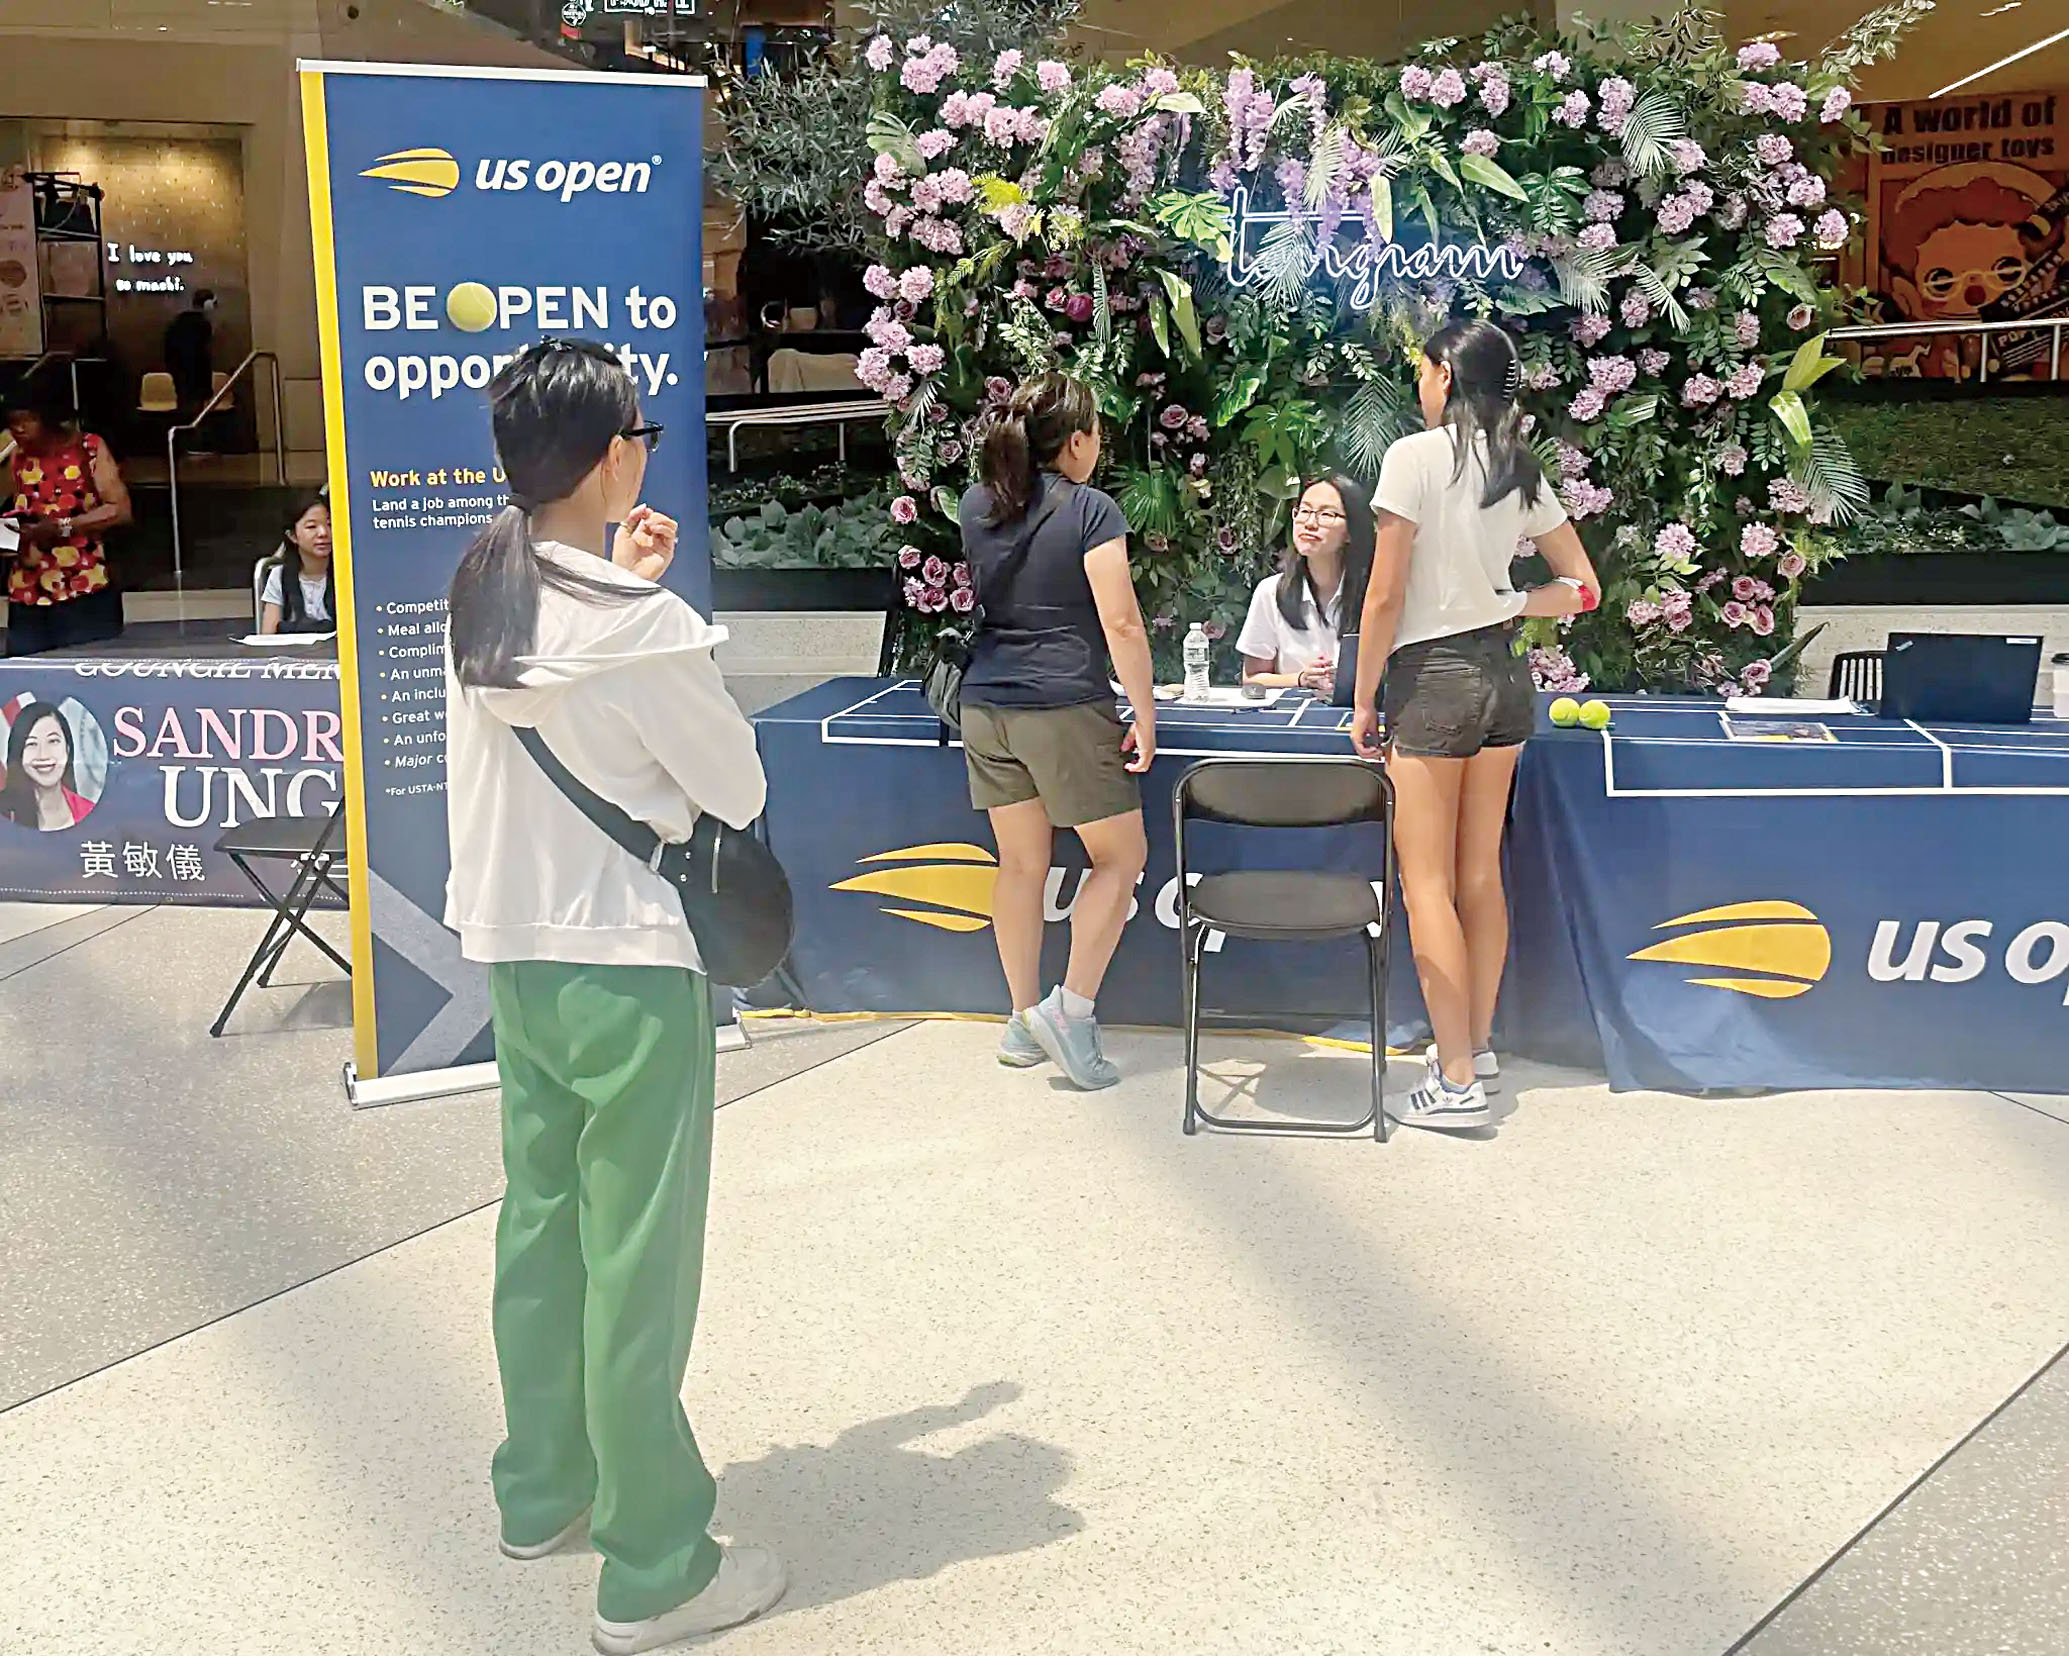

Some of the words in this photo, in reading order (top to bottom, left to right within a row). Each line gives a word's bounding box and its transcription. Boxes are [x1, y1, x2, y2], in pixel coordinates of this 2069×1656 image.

[1882, 106, 1903, 135] A
[1914, 99, 2012, 132] world
[2022, 95, 2057, 127] of
[2002, 136, 2055, 158] toys
[475, 158, 529, 191] us
[107, 242, 120, 262] I
[129, 243, 161, 263] love
[167, 251, 194, 266] you
[362, 286, 438, 331] BE
[625, 285, 677, 330] to
[370, 469, 421, 488] Work
[427, 469, 447, 485] at
[453, 467, 486, 485] the
[372, 498, 406, 512] Land
[411, 500, 419, 510] a
[423, 496, 444, 512] job
[447, 496, 493, 510] among
[373, 515, 416, 529] tennis
[420, 512, 493, 528] champions
[388, 623, 420, 636] Meal
[390, 668, 409, 681] An
[414, 667, 446, 679] unm
[392, 691, 410, 702] An
[392, 710, 431, 724] Great
[435, 710, 447, 720] w
[394, 734, 412, 746] An
[395, 754, 433, 769] Major
[79, 841, 206, 882] 黃敏儀
[1867, 920, 1993, 983] us
